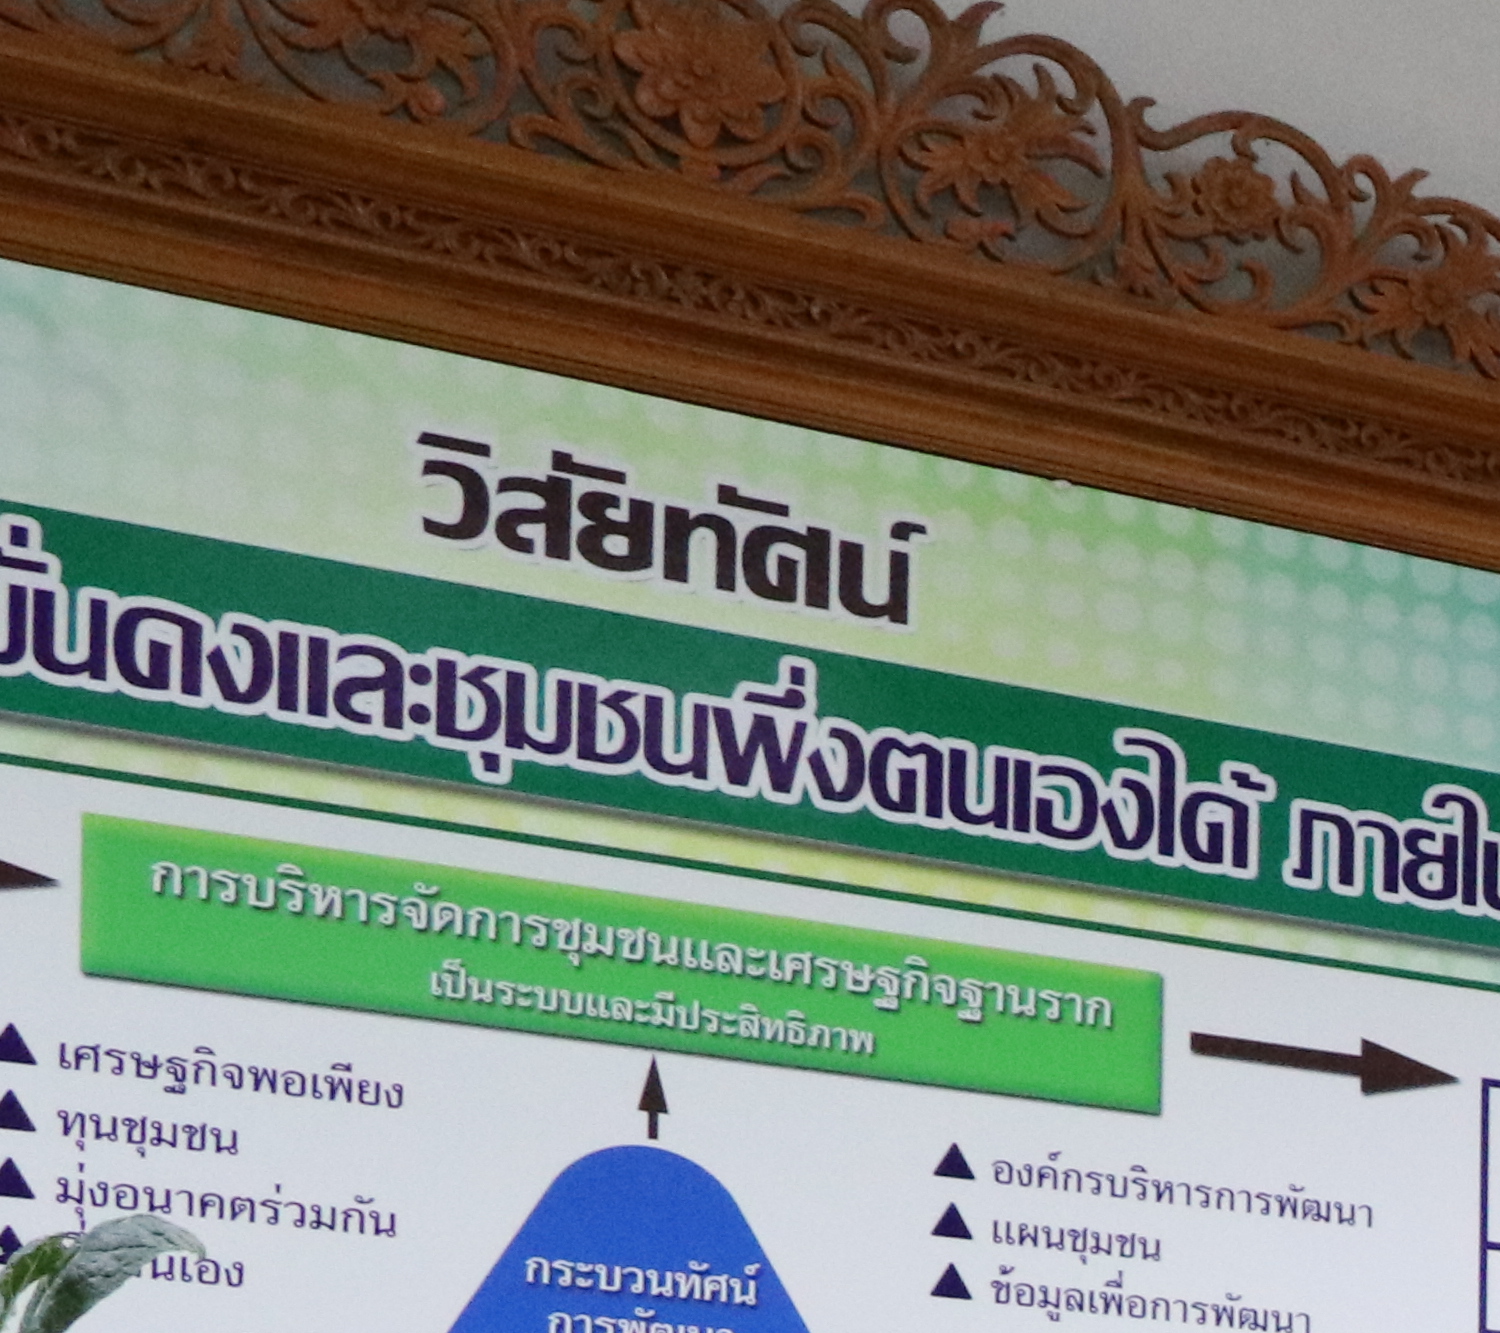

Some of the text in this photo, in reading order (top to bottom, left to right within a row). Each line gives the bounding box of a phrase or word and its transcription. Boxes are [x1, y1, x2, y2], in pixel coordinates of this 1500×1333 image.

[416, 432, 927, 624] วิสัยทัศน์
[151, 861, 1114, 1029] การบริหารจัดการชุมชนและเศรษฐกิจฐานราก
[430, 959, 875, 1054] เป็นระบบและมีประสิทธิภาพ
[58, 1039, 405, 1110] เศรษฐกิจพอเพียง
[57, 1105, 240, 1159] ทุนชุมชน
[56, 1164, 398, 1239] มุ่งอนาคตร่วมกัน
[991, 1152, 1375, 1229] องค์กรบริหารการพัฒนา
[991, 1217, 1163, 1265] แผนชุมชน
[525, 1253, 761, 1307] กระบวนทัศน์
